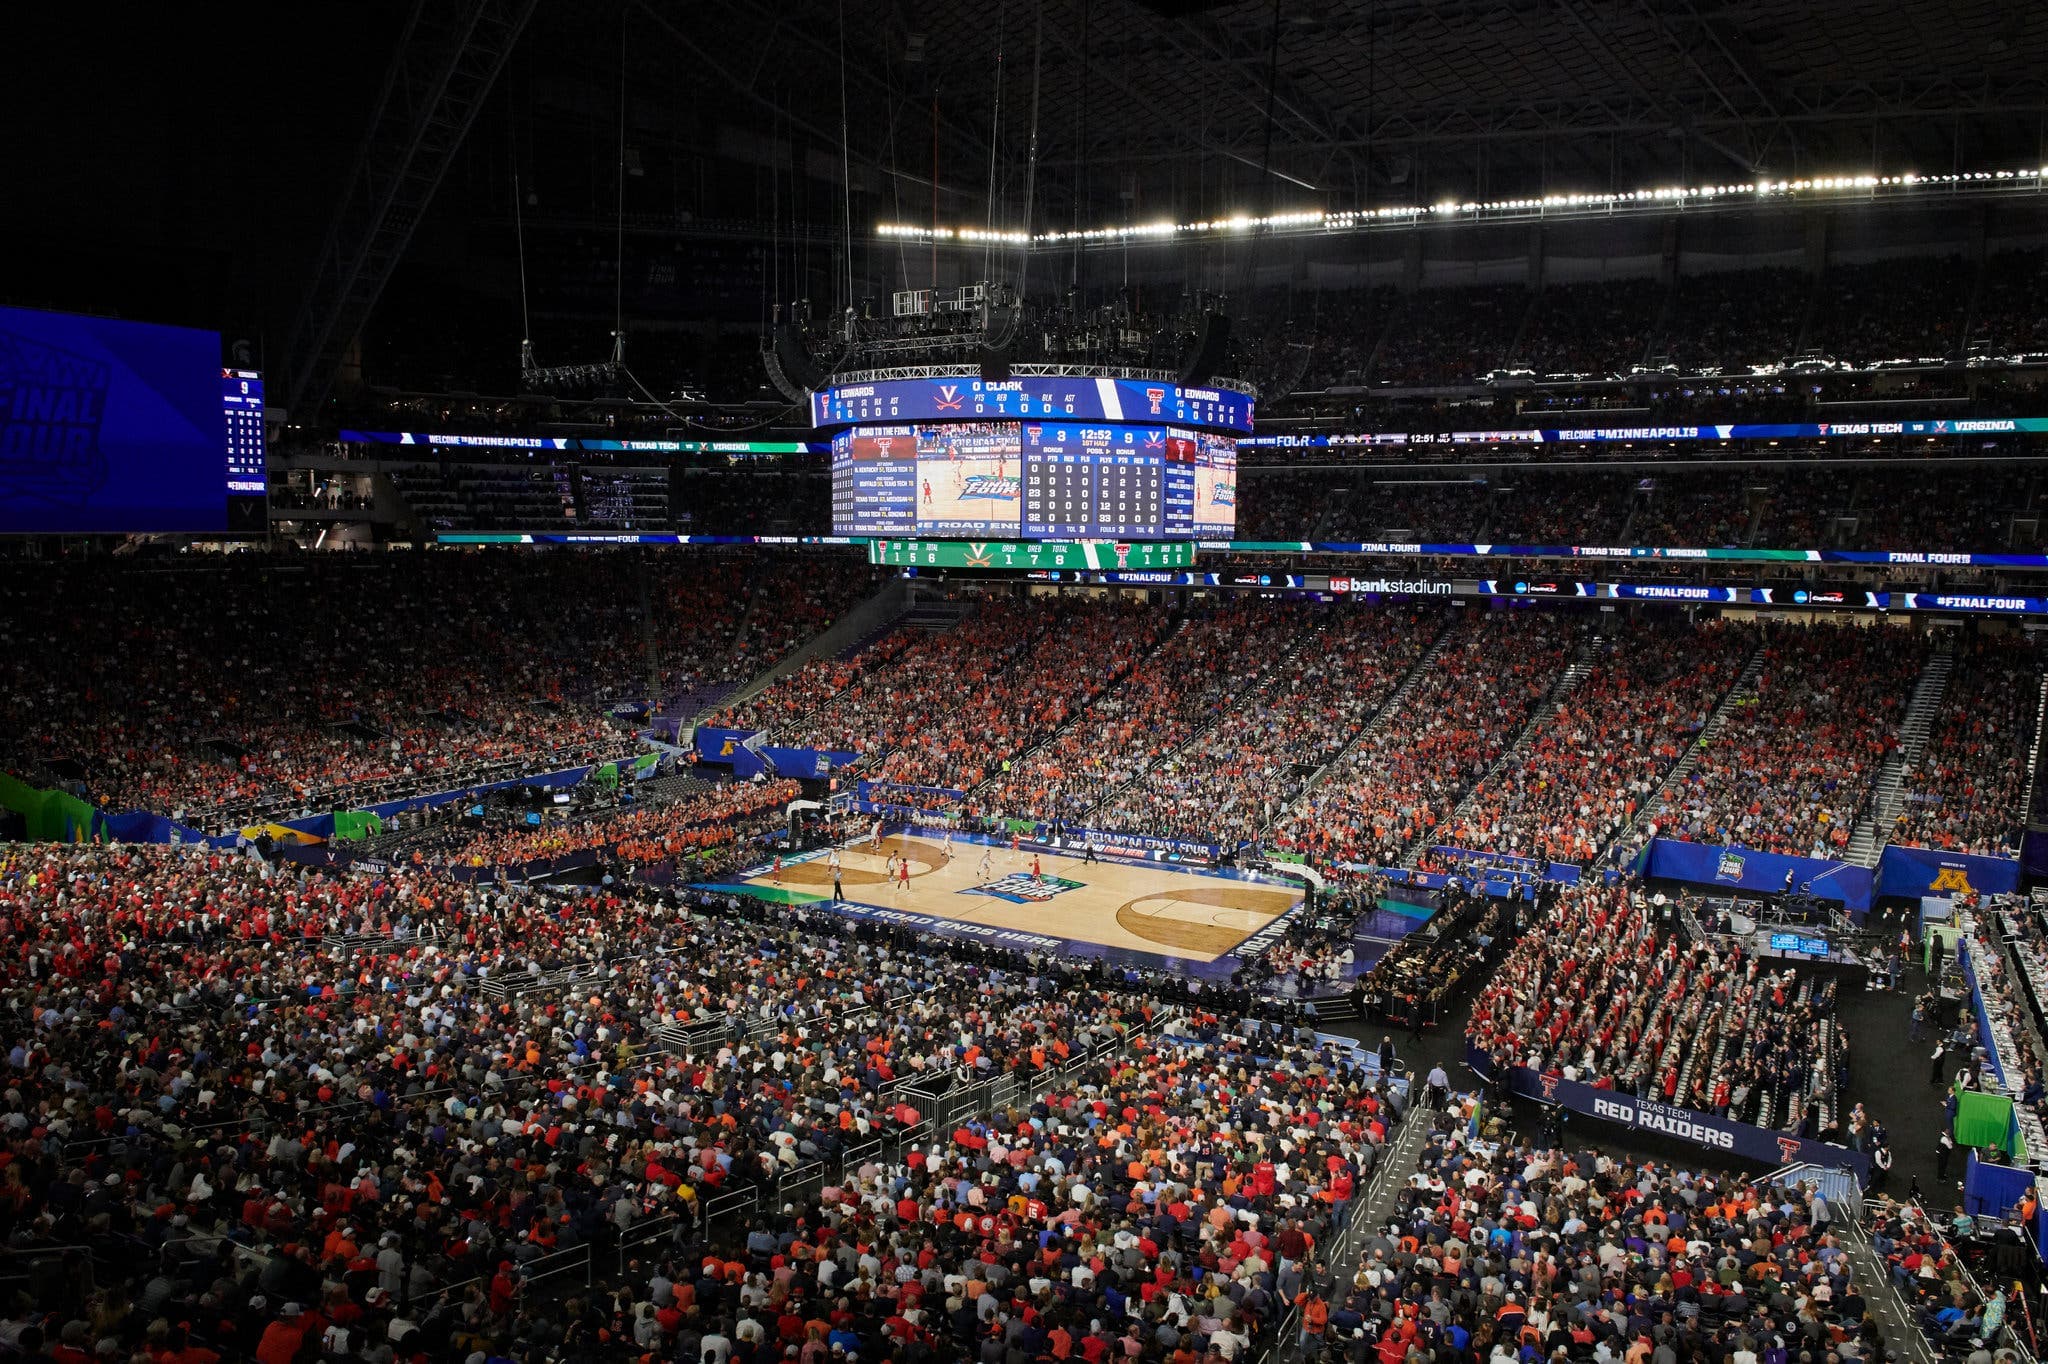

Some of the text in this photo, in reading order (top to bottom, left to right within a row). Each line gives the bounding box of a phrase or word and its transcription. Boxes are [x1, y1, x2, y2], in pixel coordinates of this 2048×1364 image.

[241, 381, 249, 394] 9
[973, 381, 1023, 391] 0 CLARK
[841, 387, 874, 399] EDWARDS
[1185, 389, 1220, 401] EDWARDS
[976, 404, 1074, 413] 0 1 0 0 0
[894, 427, 910, 436] FINAL
[1831, 424, 1870, 434] TEXAS
[1870, 424, 1903, 434] TECH
[1954, 420, 2016, 431] VIRGINIA
[1057, 431, 1066, 442] 3
[1080, 429, 1112, 440] 12:52
[1125, 433, 1133, 444] 9
[1410, 434, 1434, 443] 12:51
[1480, 433, 1485, 443] 9
[1559, 430, 1596, 441] WELCOME
[1605, 427, 1699, 439] MINNEAPOLIS
[429, 435, 461, 445] WELCOME
[468, 437, 542, 448] MINNEAPOLIS
[631, 441, 750, 451] TEXAS TECH VIRGINIA
[1032, 465, 1089, 474] 0 0 0 0
[1103, 466, 1157, 476] 0 0 1 1
[1049, 477, 1056, 485] 0
[1066, 478, 1072, 486] 1
[1082, 478, 1088, 486] 0
[1103, 478, 1157, 488] 2 2 1 0
[1029, 489, 1088, 498] 23 3 1 0
[1103, 490, 1157, 499] 5 2 2 0
[1028, 502, 1088, 510] 25 0 0 0
[1100, 502, 1157, 511] 12 0 1 0
[1028, 514, 1088, 522] 32 0 1 0
[1119, 515, 1125, 523] 0
[1135, 515, 1141, 523] 0
[1150, 515, 1156, 523] 0
[1052, 545, 1068, 553] TOTAL
[1361, 544, 1389, 553] FINAL
[1581, 547, 1608, 556] TEXAS
[1609, 548, 1631, 556] TECH
[1666, 549, 1708, 557] VIRGINIA
[910, 553, 917, 563] 5
[928, 553, 936, 563] 6
[1006, 555, 1064, 565] 1 7 8
[1162, 555, 1169, 564] 5
[1889, 553, 1926, 563] FINAL
[1635, 587, 1710, 598] #FINALFOUR
[1937, 597, 2026, 610] #FINALFOUR
[1067, 841, 1082, 849] THE
[1104, 846, 1125, 855] ENDS
[1125, 848, 1148, 858] HERE
[1114, 835, 1142, 848] NCAA
[1180, 843, 1209, 855] FOUR
[1722, 860, 1741, 868] FINAL
[832, 902, 1063, 948] THE ROAD ENDS HERE
[1635, 1099, 1692, 1121] TEXAS TECH
[1594, 1098, 1735, 1149] RED RAIDERS
[1028, 1206, 1037, 1219] 15
